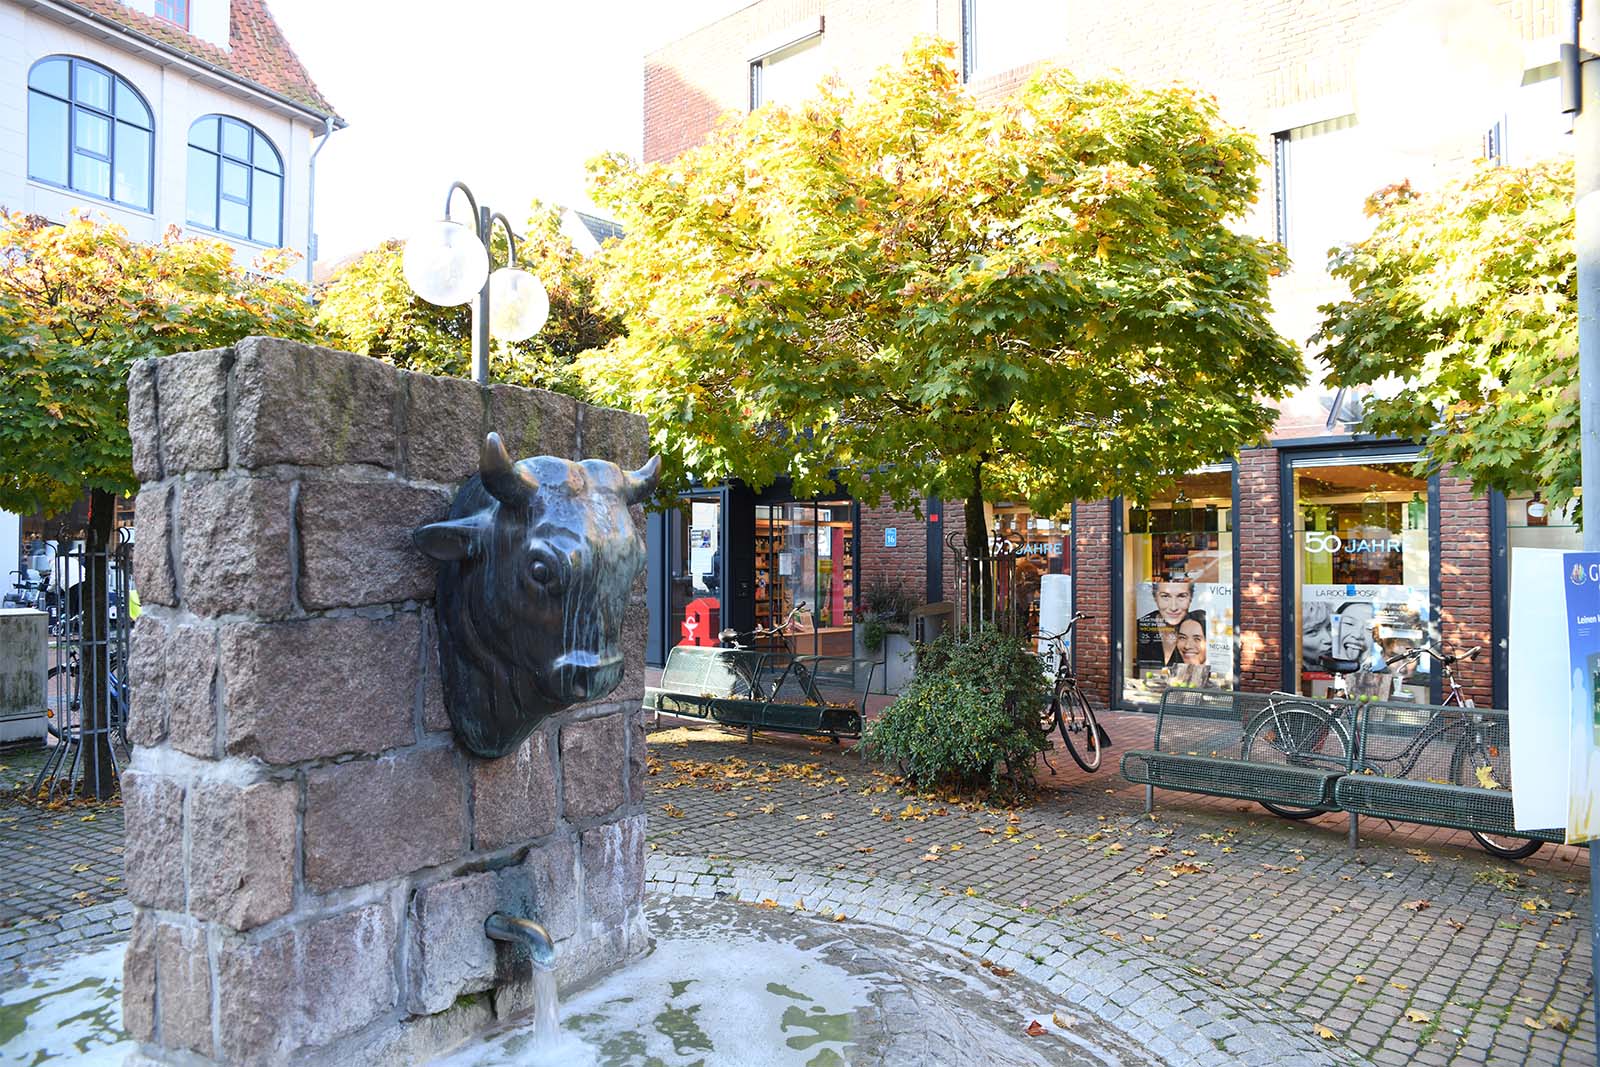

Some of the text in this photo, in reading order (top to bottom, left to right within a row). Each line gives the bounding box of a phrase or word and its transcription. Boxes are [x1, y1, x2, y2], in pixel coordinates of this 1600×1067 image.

[1304, 531, 1409, 553] 50 JAHRE
[1015, 543, 1063, 555] JAHRE
[1576, 616, 1597, 624] Leinen
